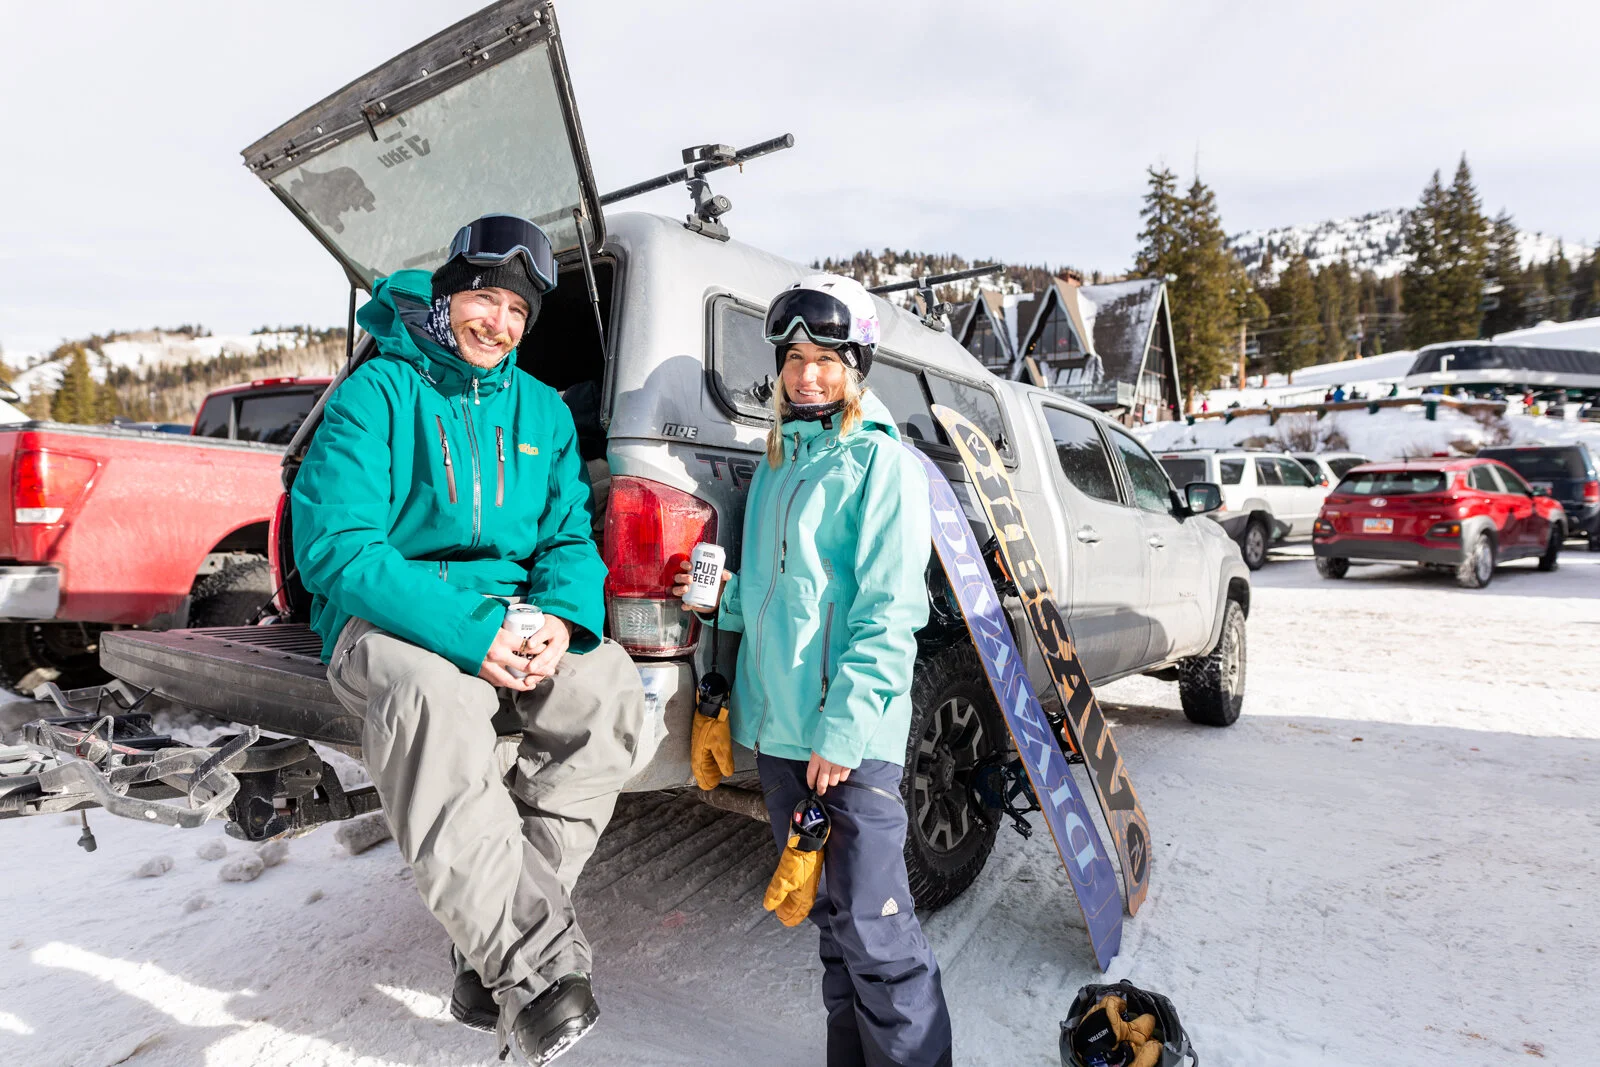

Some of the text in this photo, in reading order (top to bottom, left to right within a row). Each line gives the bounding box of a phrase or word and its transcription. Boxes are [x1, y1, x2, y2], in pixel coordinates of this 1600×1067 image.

[661, 422, 698, 440] ARE
[694, 452, 760, 490] TR
[692, 573, 716, 586] BEER
[695, 560, 718, 576] PUB
[932, 503, 1010, 681] DIVA
[975, 471, 1135, 811] JIBSAW
[1014, 678, 1099, 876] DIVA
